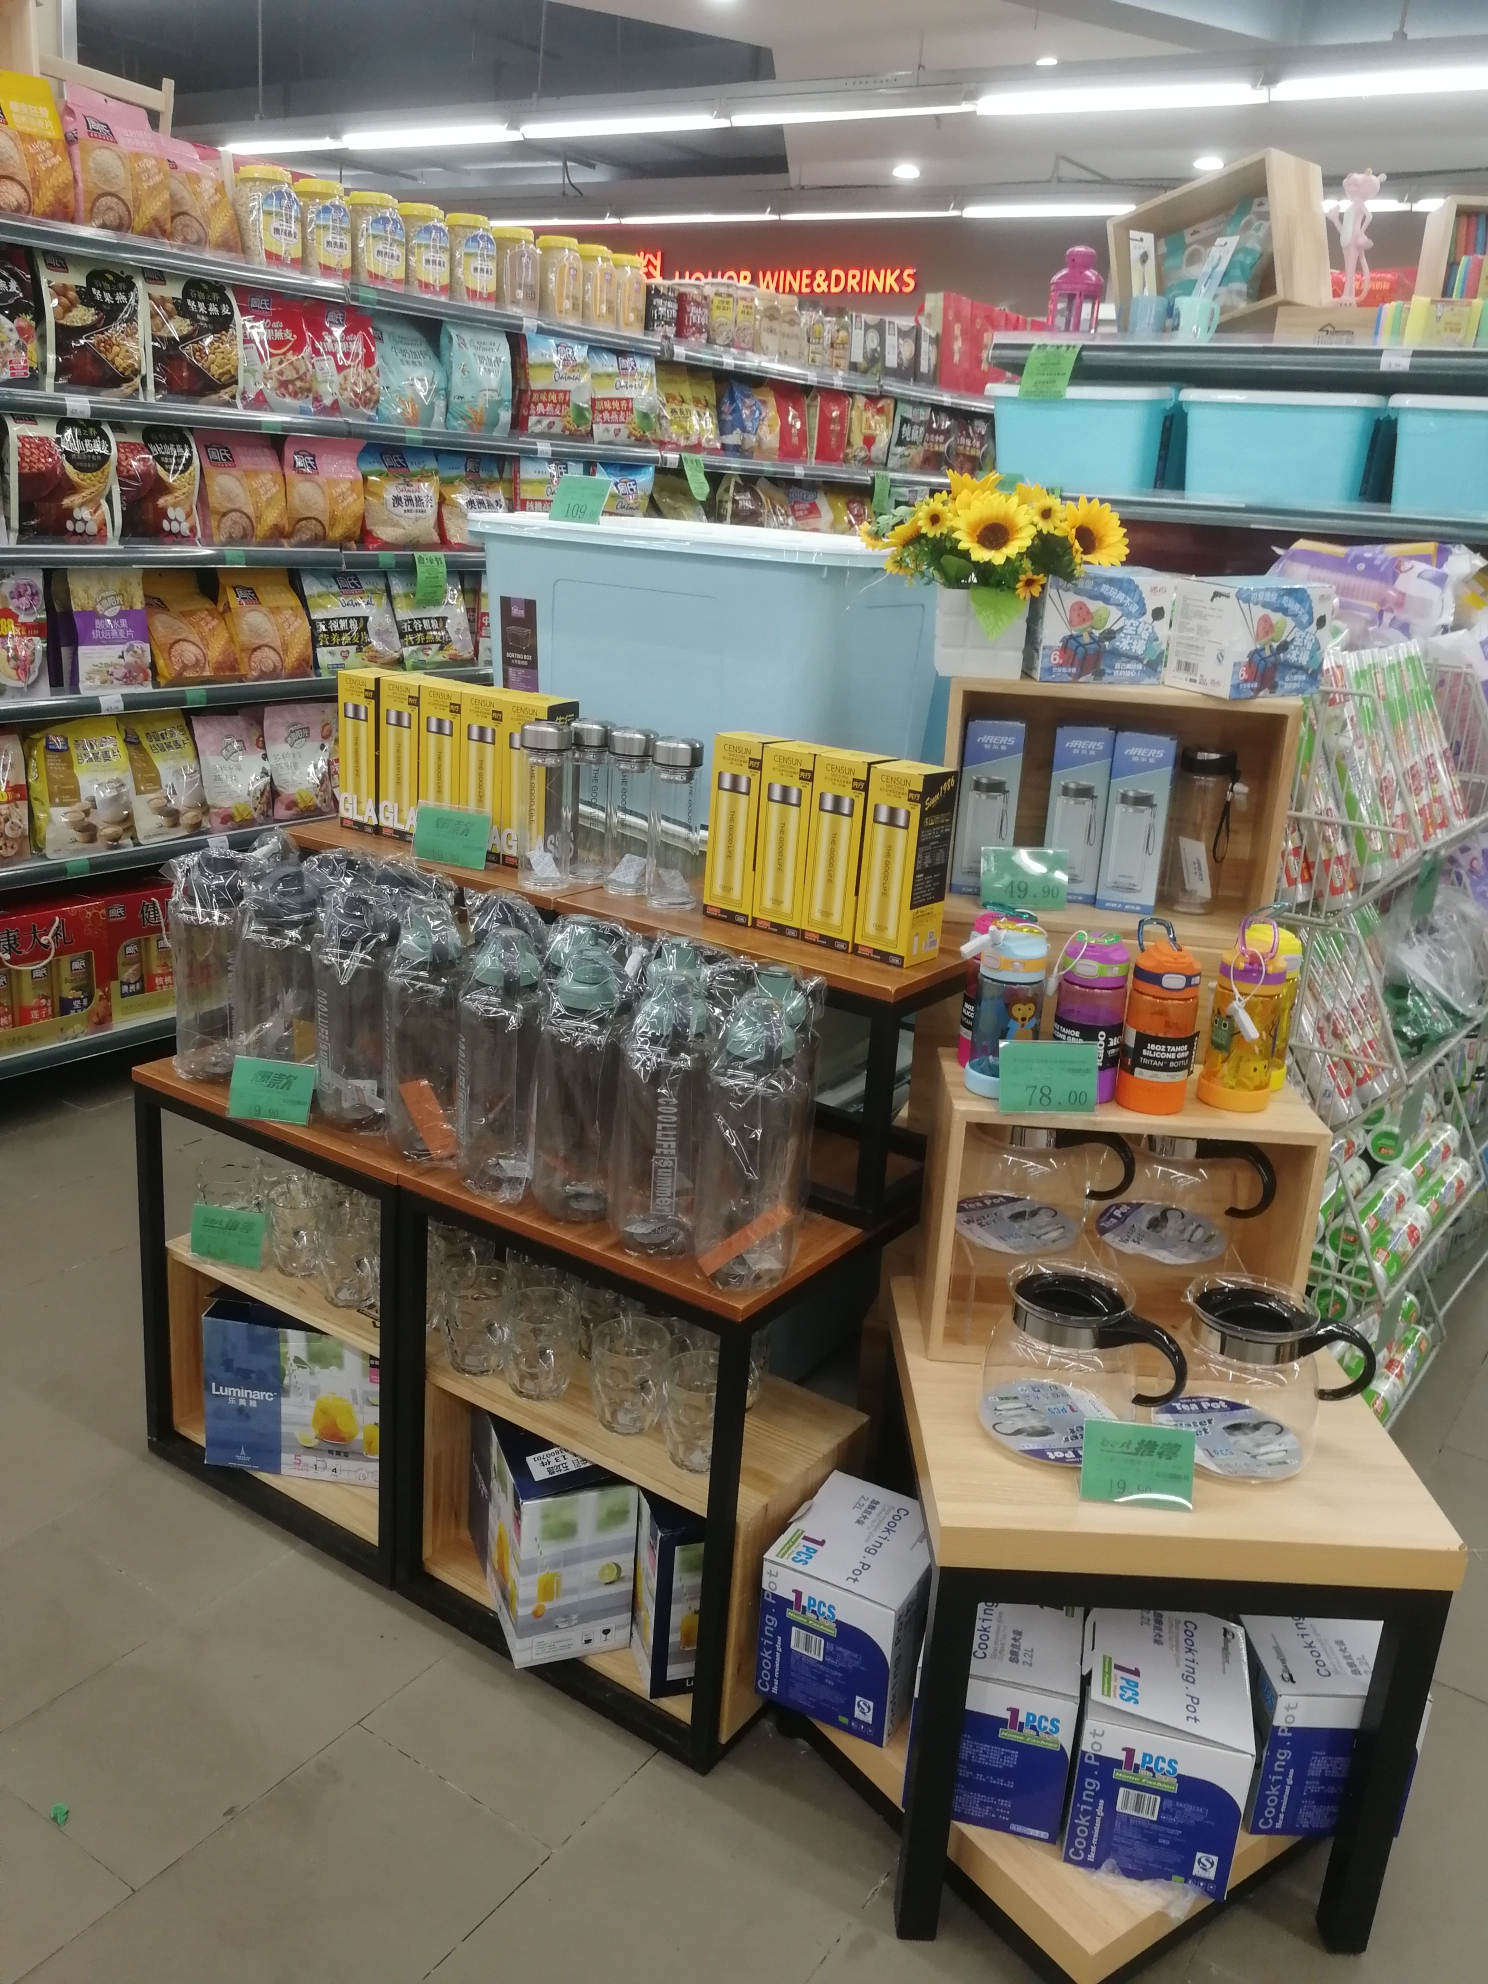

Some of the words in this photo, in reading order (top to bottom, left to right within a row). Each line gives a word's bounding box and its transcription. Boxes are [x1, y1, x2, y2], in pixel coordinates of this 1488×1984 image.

[758, 267, 917, 294] WINE&DRINKS
[428, 690, 453, 701] CENSUN
[470, 698, 495, 708] CENSUN
[511, 705, 538, 717] CENSUN
[723, 743, 752, 756] CENSUN
[773, 754, 803, 766] CENSUN
[825, 763, 856, 776] CENSUN
[880, 774, 912, 788] CENSUN
[1003, 880, 1061, 900] 49.90
[1096, 1030, 1107, 1067] IGLOO
[1142, 1049, 1177, 1059] SILICONE
[1025, 1085, 1089, 1108] 78.00
[655, 1097, 678, 1158] COOLLIFE
[211, 1382, 275, 1402] Luminarc
[1172, 1401, 1199, 1411] Tea
[1201, 1400, 1229, 1410] Pot
[806, 1595, 837, 1622] PCS
[1118, 1676, 1140, 1705] PCS
[1024, 1711, 1061, 1735] PCS
[1140, 1752, 1179, 1776] PCS
[1115, 1770, 1141, 1783] Home
